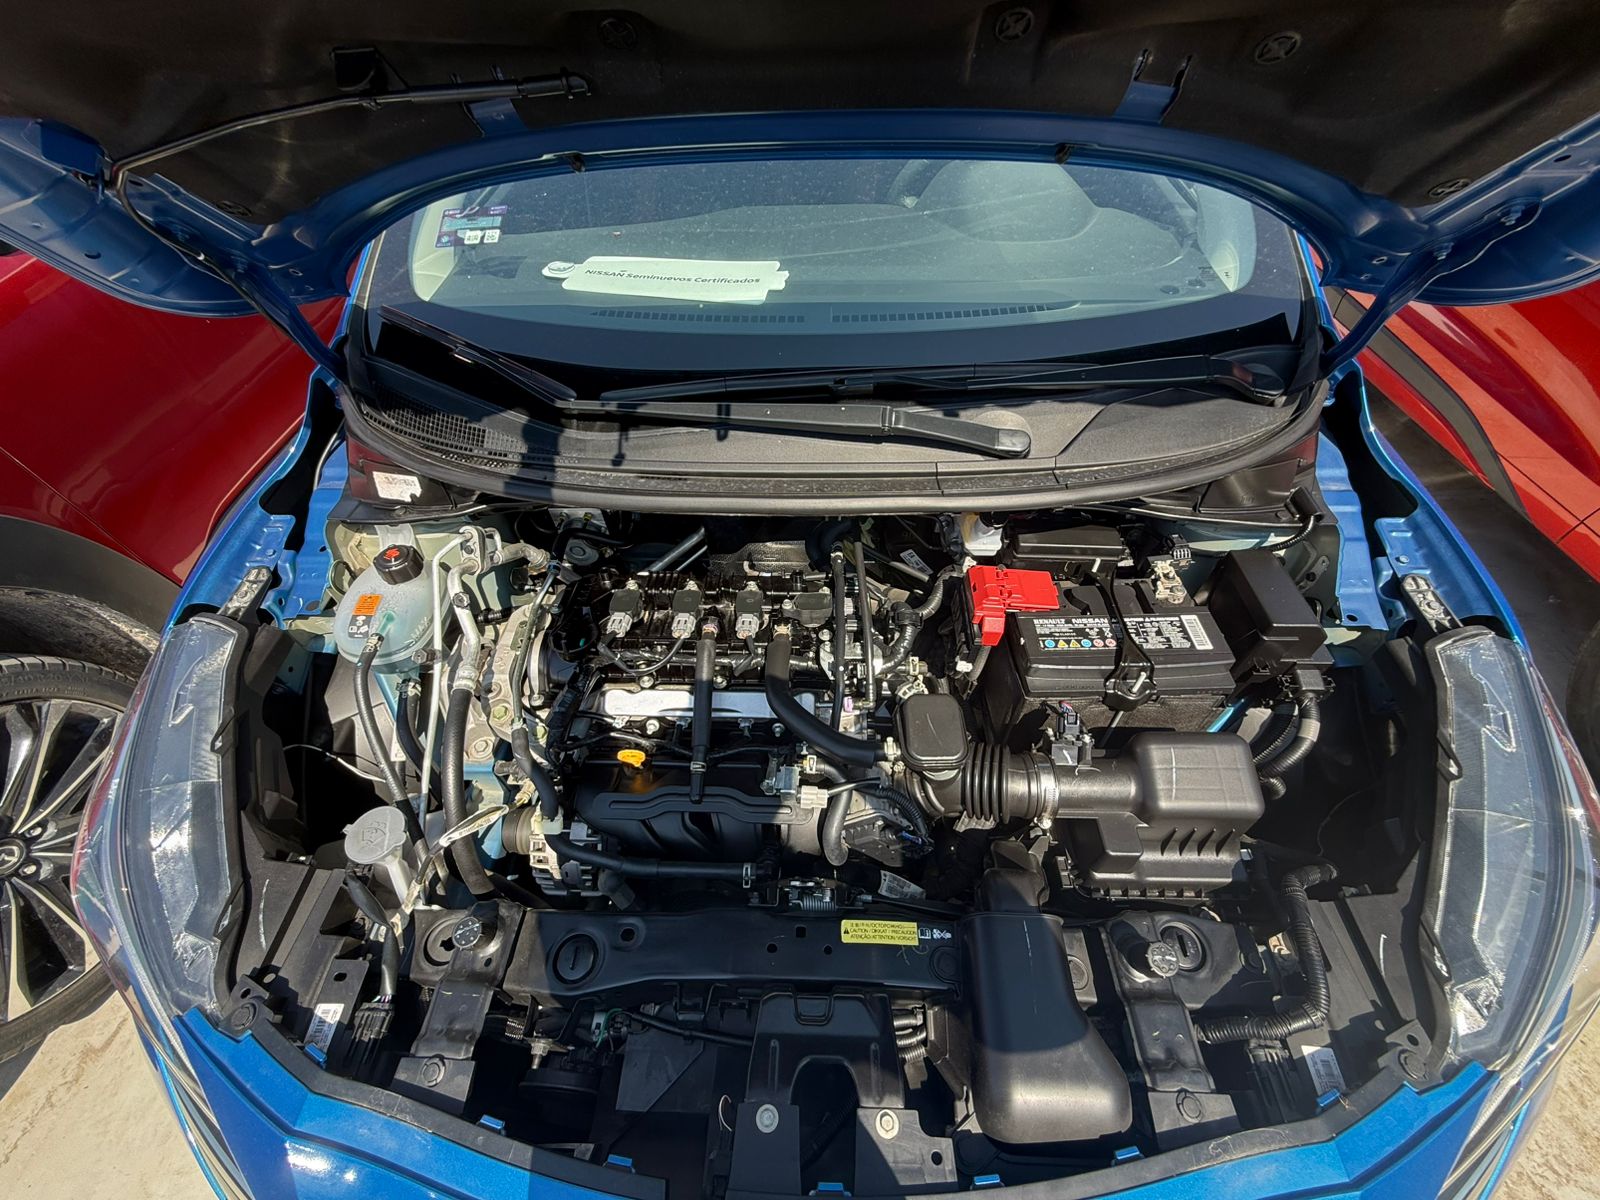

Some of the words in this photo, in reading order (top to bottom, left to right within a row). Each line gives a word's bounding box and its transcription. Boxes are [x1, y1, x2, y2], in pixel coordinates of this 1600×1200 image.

[584, 268, 626, 278] NISSAN
[626, 273, 694, 283] Seminuevos
[694, 276, 761, 285] Certificados
[1071, 617, 1109, 625] NISSAN
